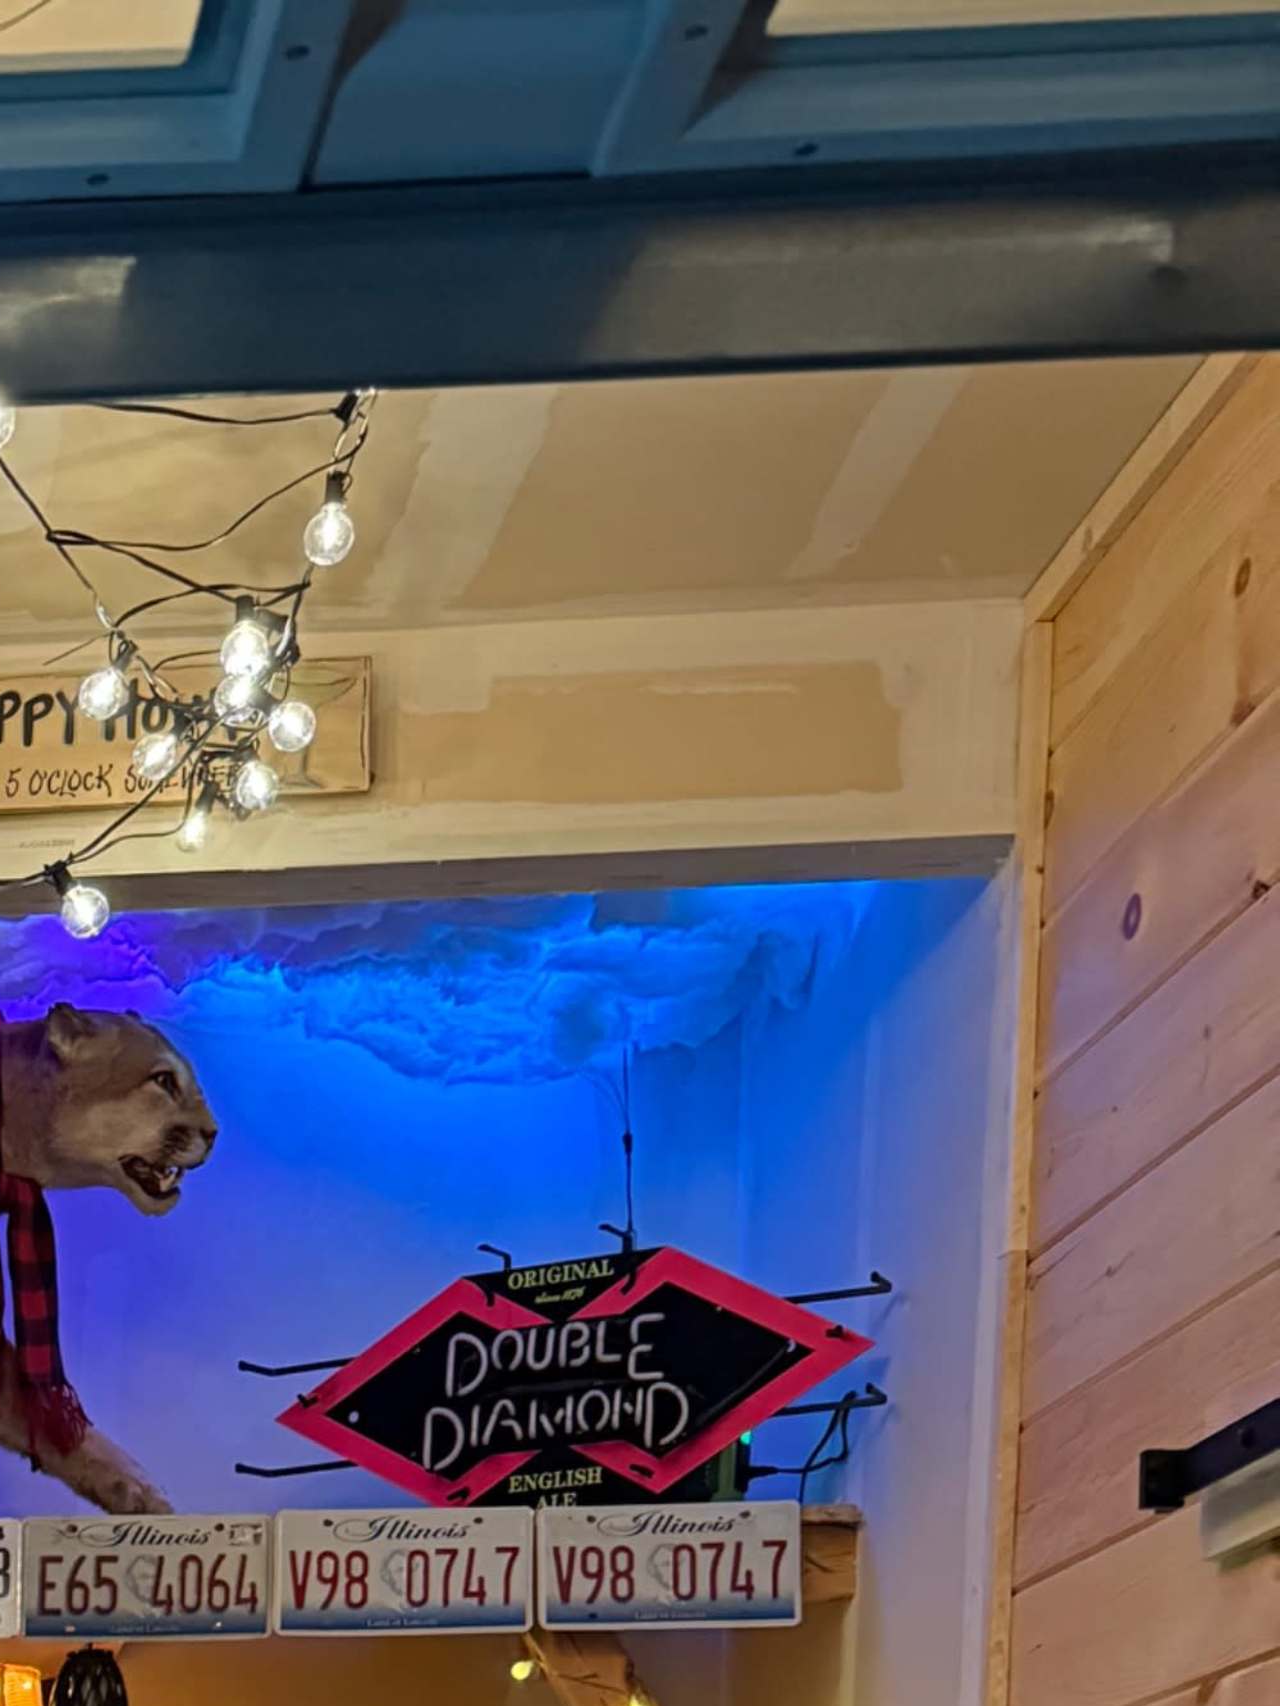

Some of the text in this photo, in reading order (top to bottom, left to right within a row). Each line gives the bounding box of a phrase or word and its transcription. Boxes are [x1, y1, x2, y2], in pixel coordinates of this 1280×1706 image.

[5, 768, 22, 798] 5
[29, 764, 114, 798] O'CLOCK
[507, 1258, 615, 1290] ORIGINAL
[445, 1312, 665, 1398] DOUBLE
[422, 1381, 689, 1472] DIAMOND
[507, 1465, 604, 1494] ENGLISH
[538, 1492, 578, 1508] ALE
[78, 1520, 212, 1548] Illinois
[332, 1515, 470, 1543] Illinois
[596, 1510, 737, 1537] Illinois
[37, 1553, 258, 1617] E65 4064
[288, 1547, 521, 1611] V98 0747
[552, 1540, 788, 1605] V98 0747
